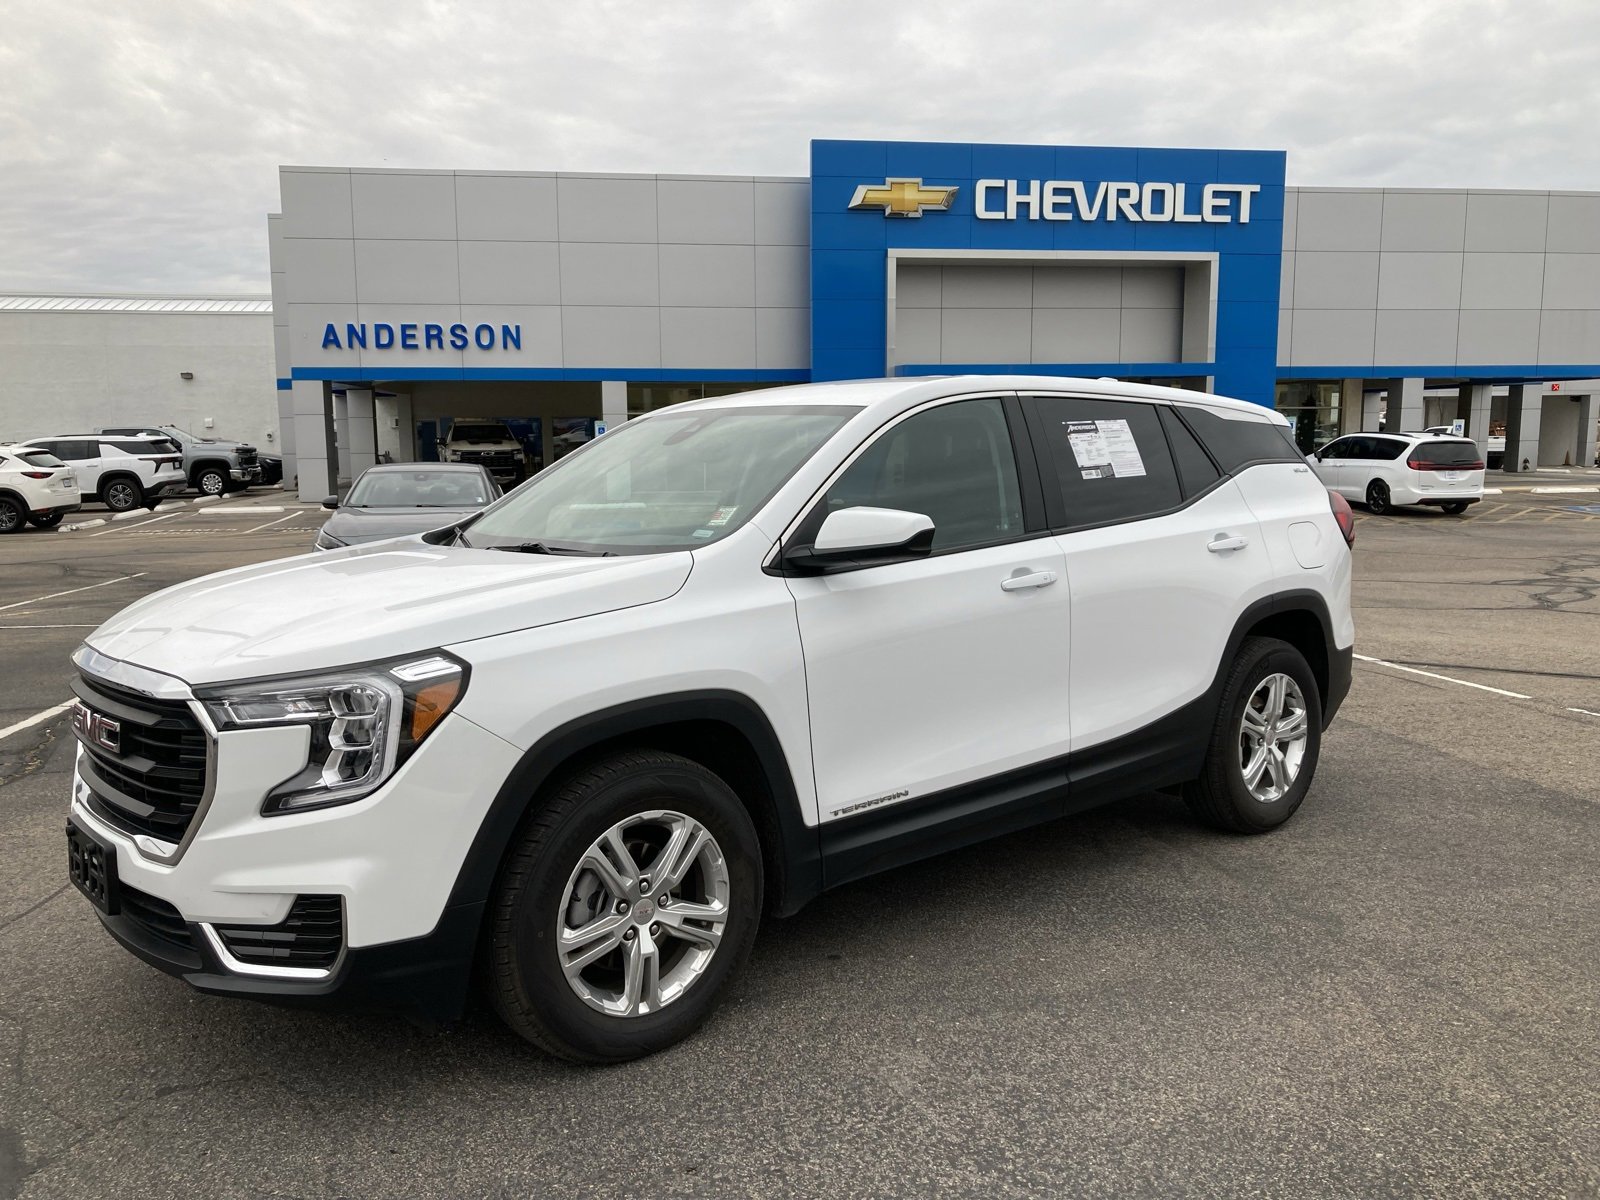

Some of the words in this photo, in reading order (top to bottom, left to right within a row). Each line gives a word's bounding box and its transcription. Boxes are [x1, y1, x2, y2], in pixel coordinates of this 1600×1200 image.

[975, 179, 1261, 223] CHEVROLET
[321, 323, 521, 350] ANDERSON
[73, 702, 121, 753] GMC
[829, 790, 910, 816] TERRAIN
